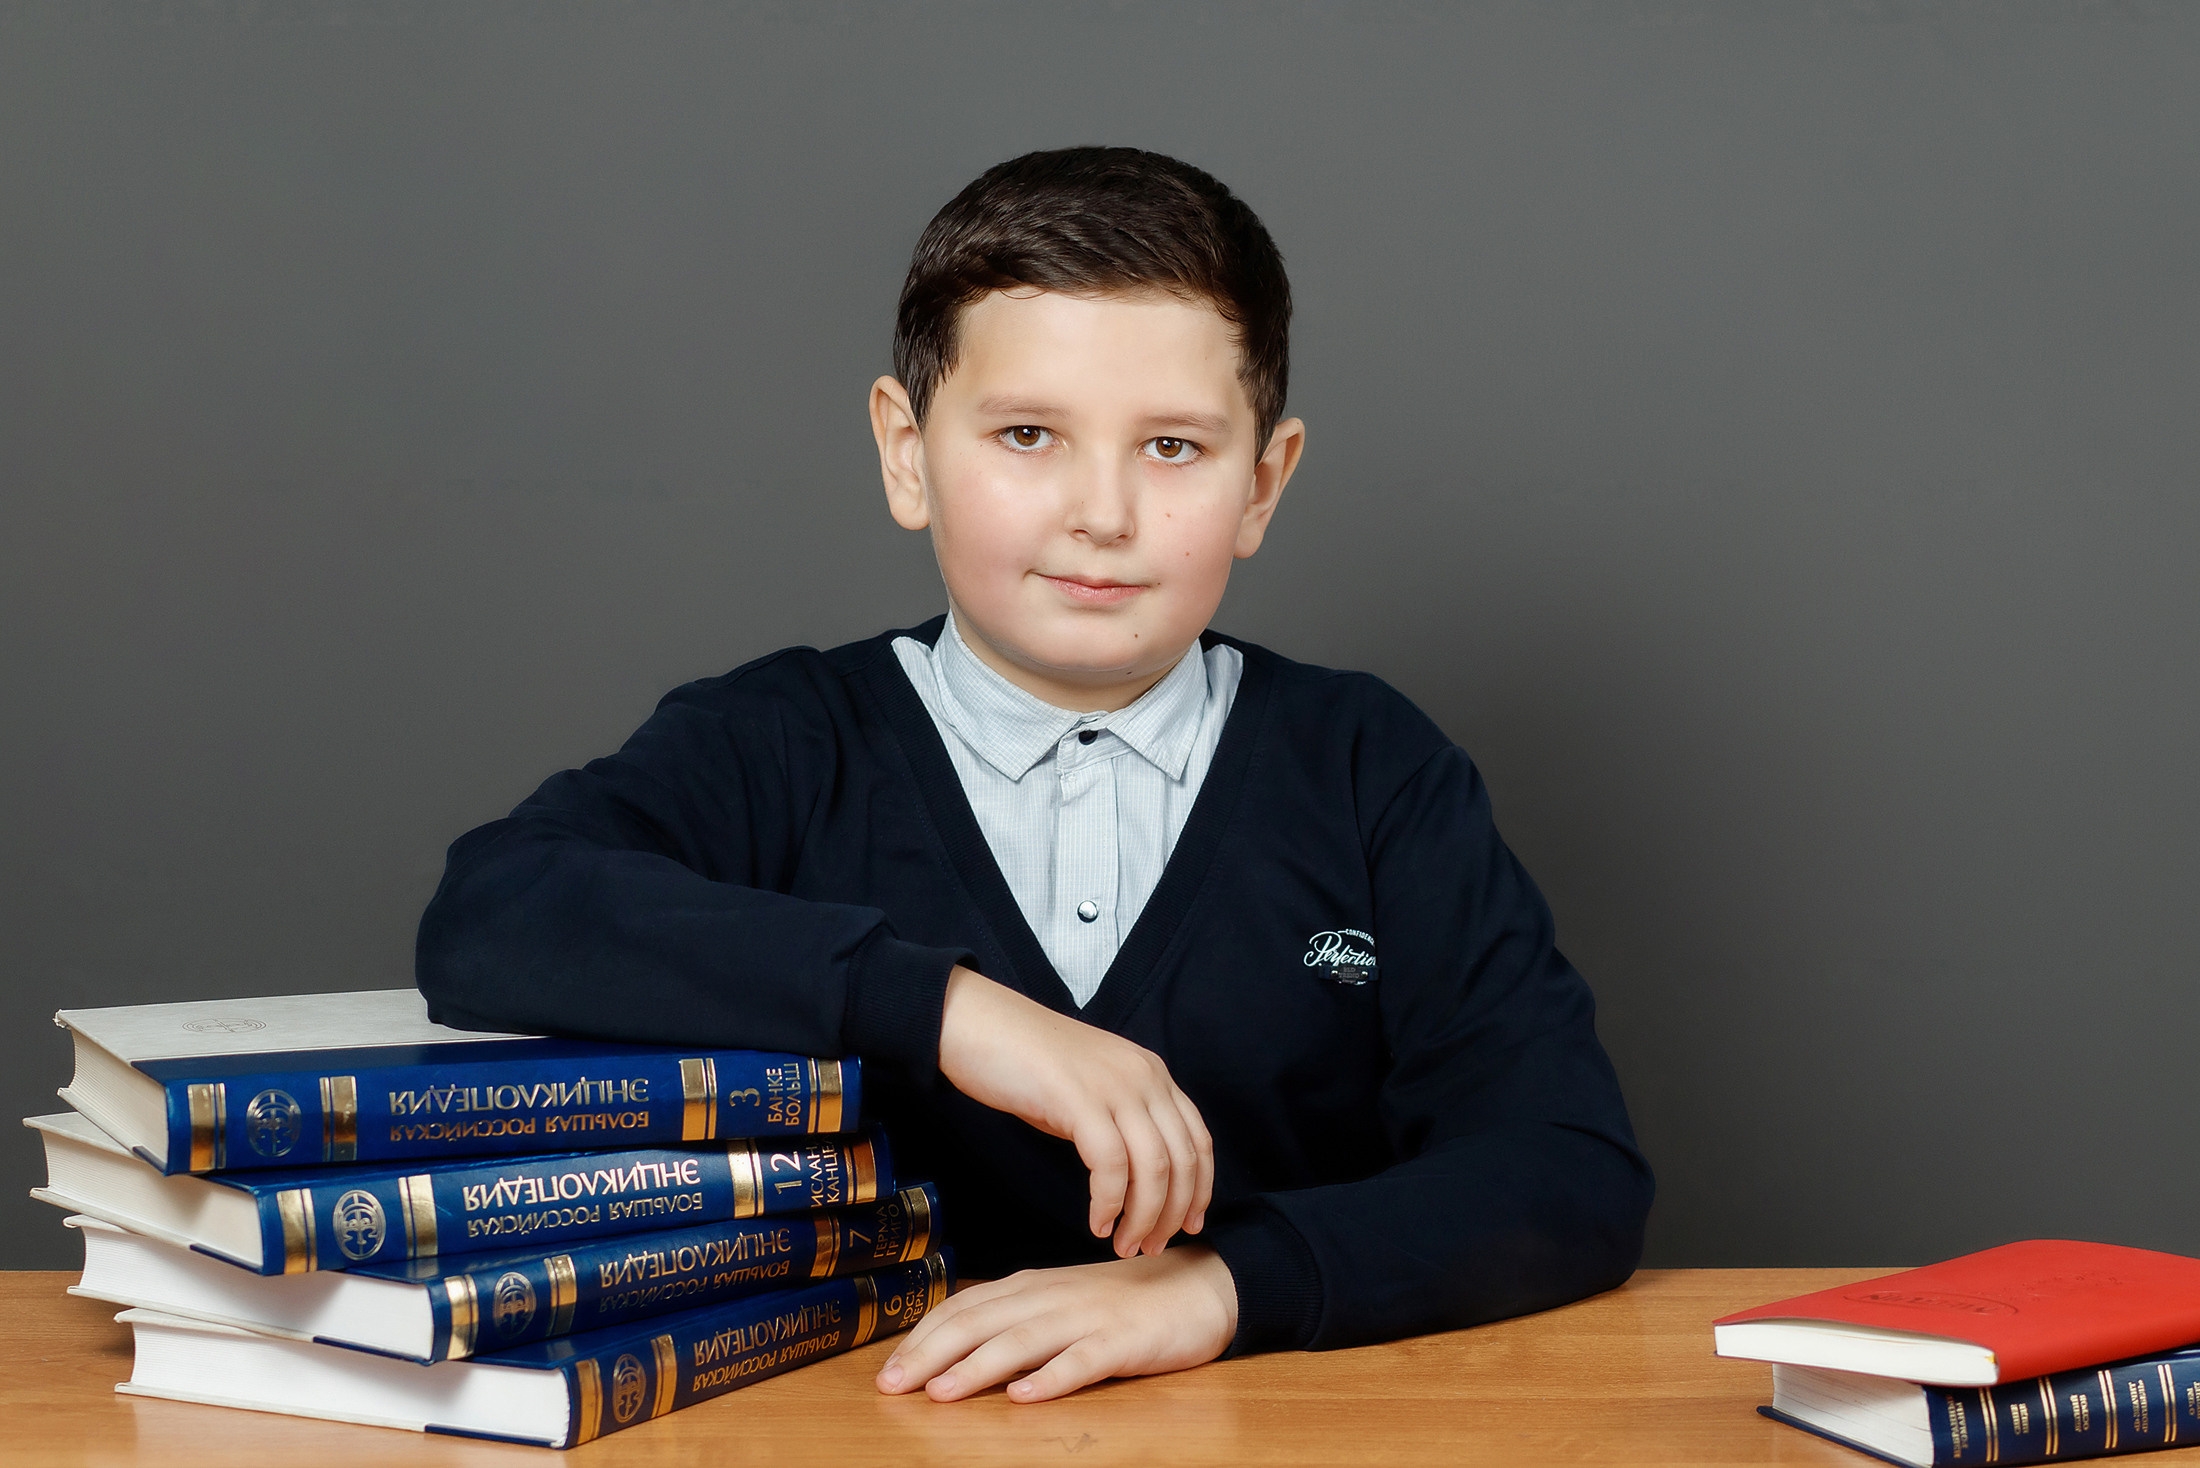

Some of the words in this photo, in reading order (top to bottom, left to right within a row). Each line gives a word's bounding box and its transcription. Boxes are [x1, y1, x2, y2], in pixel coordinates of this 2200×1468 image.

[1345, 928, 1376, 949] CONFIDENC
[388, 1076, 650, 1116] ЭНЦИКЛОПЕДИЯ
[729, 1087, 761, 1108] 3
[766, 1067, 783, 1123] БАНКЕ
[784, 1062, 801, 1126] БОЛЬШ
[389, 1116, 537, 1142] РОССИЙСКАЯ
[545, 1110, 651, 1133] БОЛЬШАЯ
[462, 1159, 701, 1211] ЭНЦИКЛОПЕДИЯ
[770, 1150, 803, 1195] 12
[805, 1145, 825, 1208] ИСЛАН
[467, 1204, 600, 1238] РОССИЙСКАЯ
[608, 1192, 703, 1221] БОЛЬШАЯ
[848, 1228, 872, 1248] 7
[873, 1205, 889, 1258] ГЕРМА
[886, 1203, 901, 1256] ГРИГО
[599, 1228, 791, 1289] ЭНЦИКЛОПЕДИЯ
[712, 1259, 791, 1290] БОЛЬШАЯ
[598, 1275, 708, 1313] РОССИЙСКАЯ
[884, 1294, 903, 1316] 6
[693, 1299, 842, 1366] ЭНЦИКЛОПЕДИЯ
[780, 1330, 841, 1364] БОЛЬШАЯ
[692, 1350, 777, 1392] РОССИЙСКАЯ
